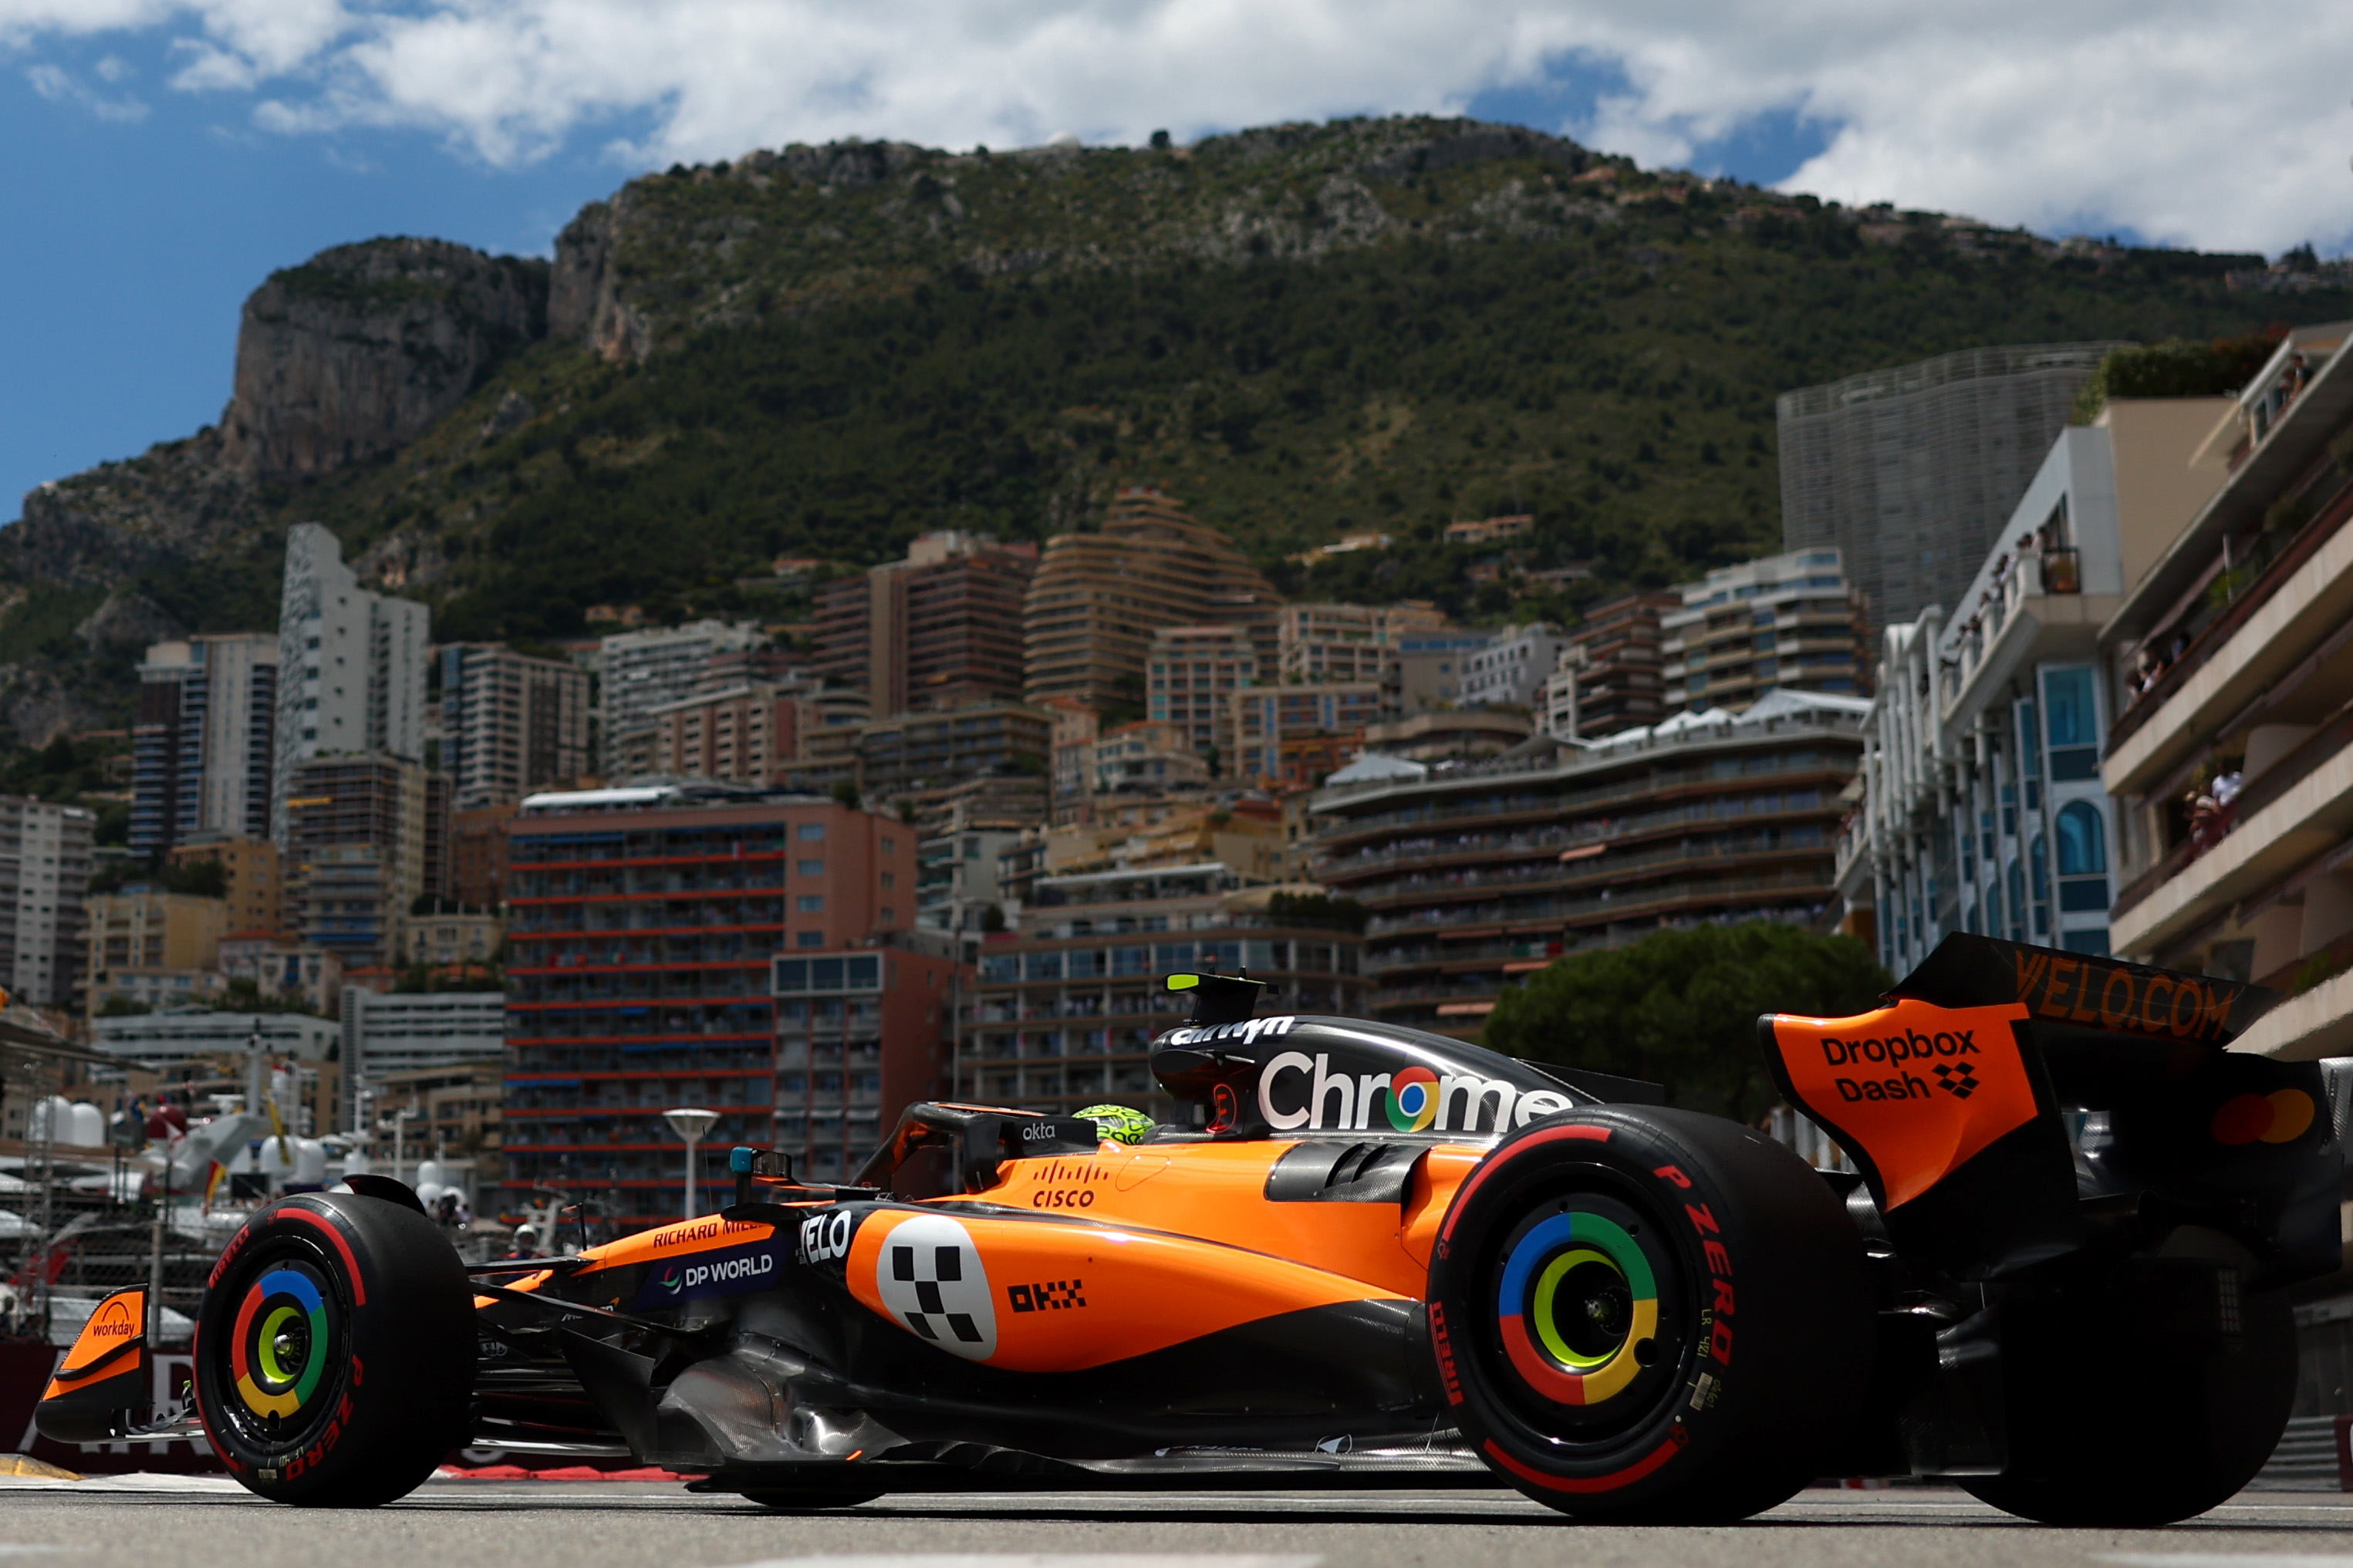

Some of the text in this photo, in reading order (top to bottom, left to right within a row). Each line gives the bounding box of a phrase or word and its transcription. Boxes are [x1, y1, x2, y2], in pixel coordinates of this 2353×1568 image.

[1820, 1028, 1981, 1068] Dropbox
[1258, 1050, 1574, 1132] Chrome
[1835, 1071, 1932, 1102] Dash
[1022, 1122, 1055, 1141] okta
[1033, 1190, 1095, 1208] CISCO
[653, 1222, 717, 1248] RICHARD
[208, 1223, 251, 1290] PIRELLI
[685, 1266, 708, 1286] DP
[711, 1254, 772, 1283] WORLD
[1652, 1165, 1735, 1366] P ZERO
[1007, 1279, 1087, 1313] OKX
[93, 1319, 135, 1338] workday
[1429, 1300, 1465, 1406] PIRELLI
[286, 1353, 365, 1481] P ZERO
